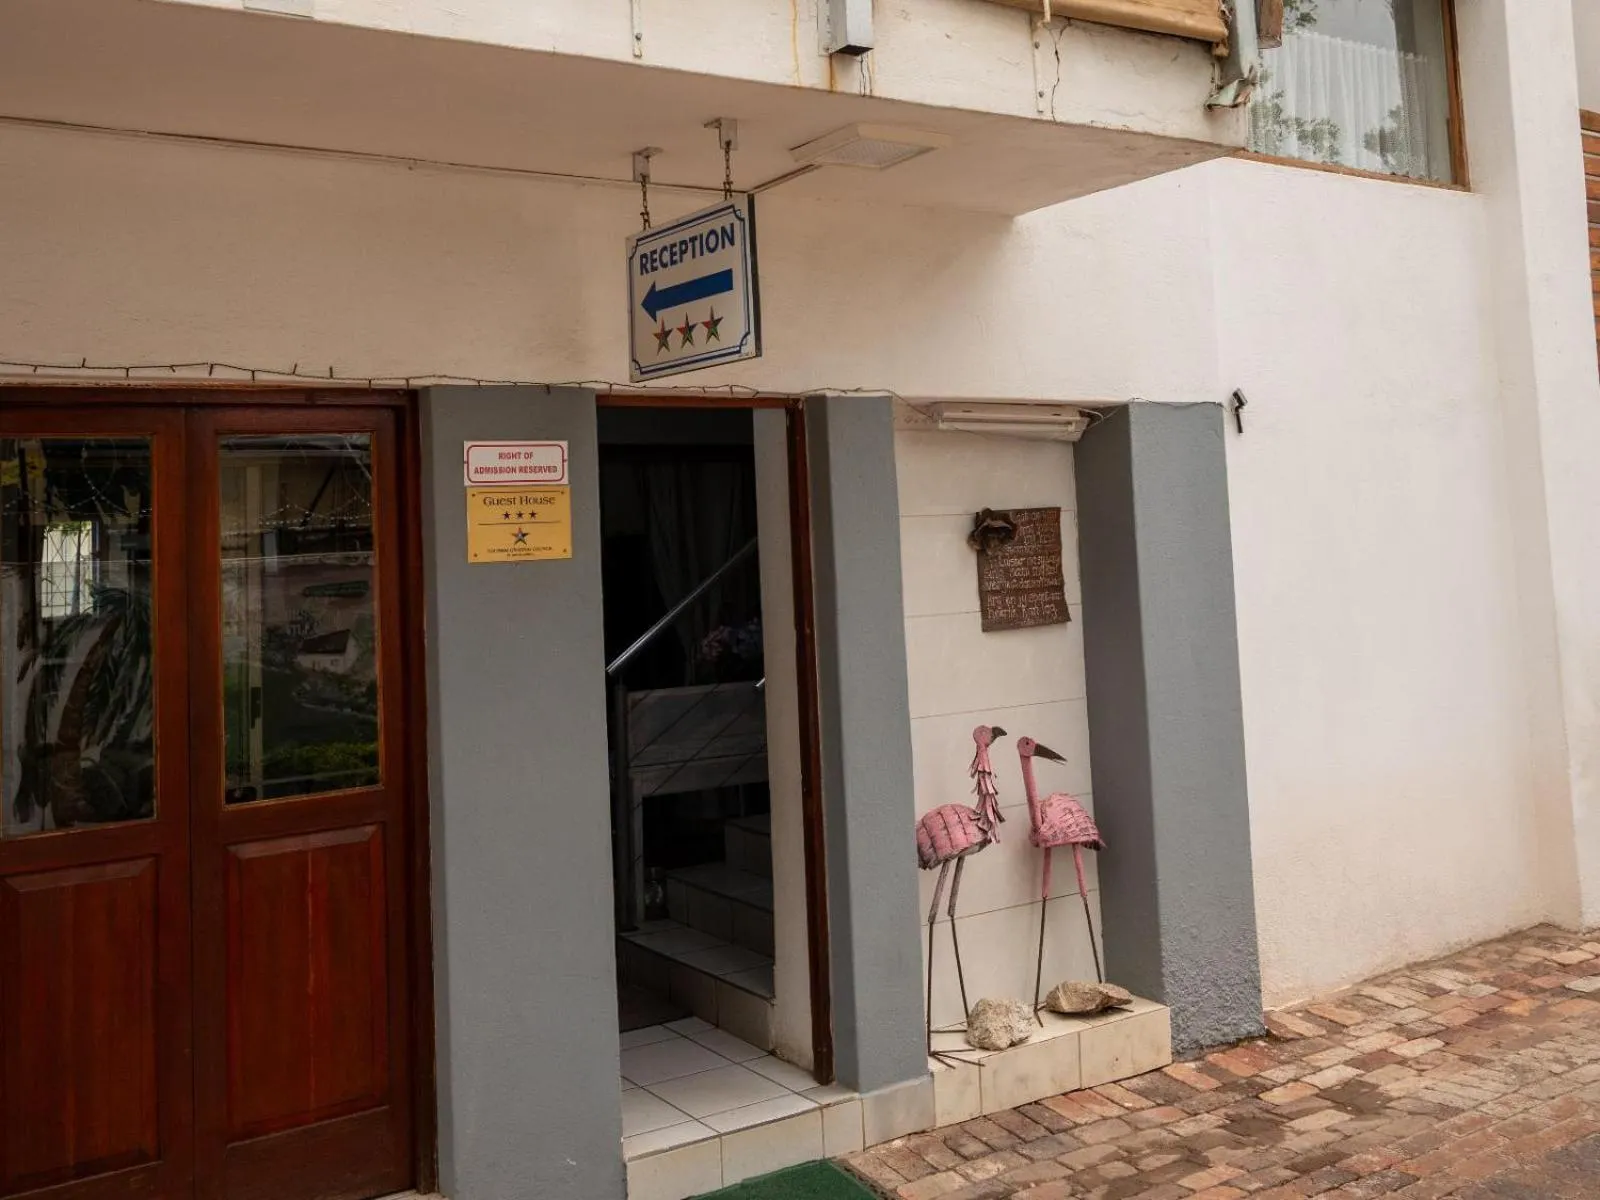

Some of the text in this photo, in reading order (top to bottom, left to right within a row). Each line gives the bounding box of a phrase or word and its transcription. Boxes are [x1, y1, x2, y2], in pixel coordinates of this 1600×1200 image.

[639, 222, 736, 276] RECEPTION
[498, 451, 534, 460] RIGHT OF
[474, 465, 558, 475] ADMISSION RESERVED
[482, 494, 556, 506] Guest House
